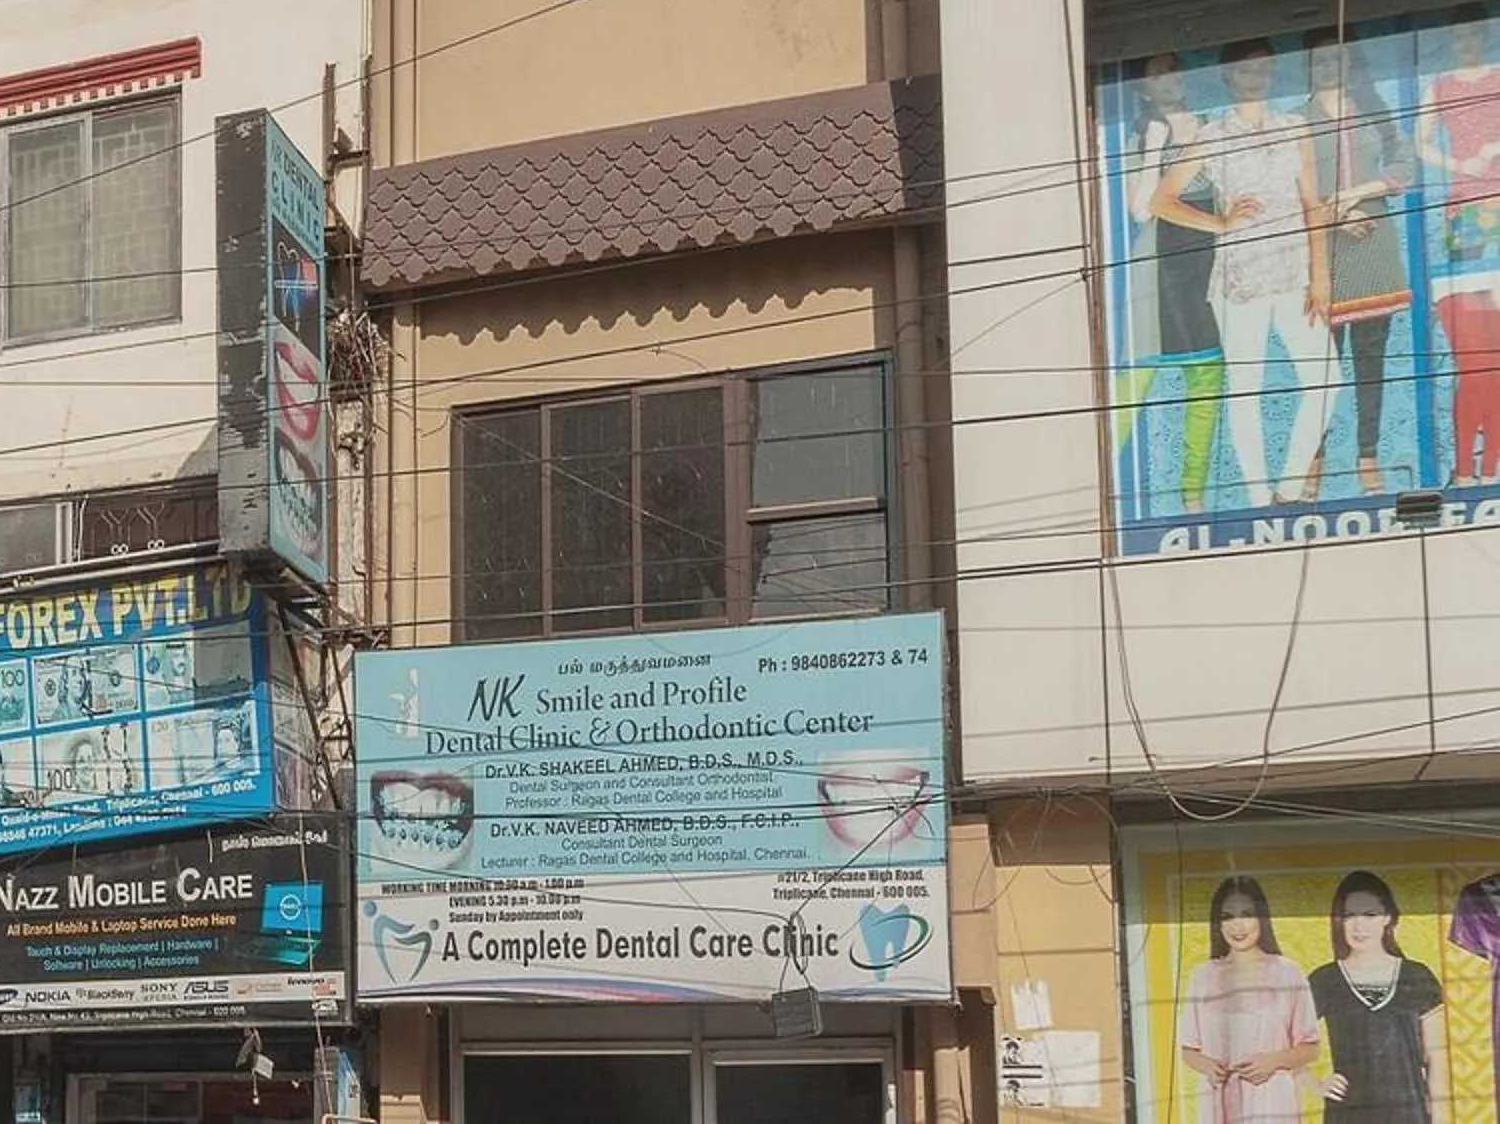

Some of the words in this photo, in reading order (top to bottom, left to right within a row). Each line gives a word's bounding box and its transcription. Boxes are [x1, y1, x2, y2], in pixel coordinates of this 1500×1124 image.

[758, 657, 777, 674] Ph
[790, 651, 885, 672] 9840862273
[891, 649, 903, 666] &
[908, 648, 929, 665] 74
[467, 674, 526, 723] NK
[536, 684, 604, 715] Smile
[610, 680, 655, 710] and
[663, 675, 748, 707] Profile
[425, 726, 502, 755] Dental
[509, 723, 581, 750] Clinic
[589, 717, 610, 746] &
[616, 712, 777, 745] Orthodontic
[783, 709, 875, 737] Center
[485, 762, 535, 779] Dr.V.K.
[539, 759, 616, 777] SHAKEEL
[509, 781, 547, 794] Dental
[550, 778, 600, 794] Surgeon
[603, 776, 625, 789] and
[629, 773, 695, 790] Consultant
[505, 796, 562, 810] Professor
[571, 793, 609, 809] Ragas
[613, 791, 653, 805] Dental
[655, 789, 701, 805] College
[704, 787, 729, 801] and
[731, 785, 783, 801] Hospital
[490, 822, 541, 838] Dr.V.K.
[545, 818, 609, 835] NAVEED
[561, 836, 625, 852] Consultant
[628, 835, 667, 849] Dental
[670, 833, 723, 849] Surgeon
[481, 855, 529, 869] Lecturer
[538, 853, 577, 869] Ragas
[579, 851, 618, 866] Dental
[621, 849, 667, 866] College
[669, 849, 693, 863] and
[68, 874, 167, 909] MOBILE
[176, 867, 253, 901] CARE
[23, 923, 52, 936] Brand
[55, 921, 89, 935] Mobile
[102, 919, 137, 934] Laptop
[140, 916, 179, 931] Service
[181, 914, 209, 928] Done
[211, 912, 236, 926] Here
[449, 911, 483, 924] Sunday
[442, 931, 460, 962] A
[468, 928, 587, 968] Complete
[596, 926, 685, 959] Dental
[690, 926, 752, 959] Care
[762, 924, 839, 959] Clinic
[25, 991, 70, 1004] NOKIA
[183, 979, 230, 994] ASUS
